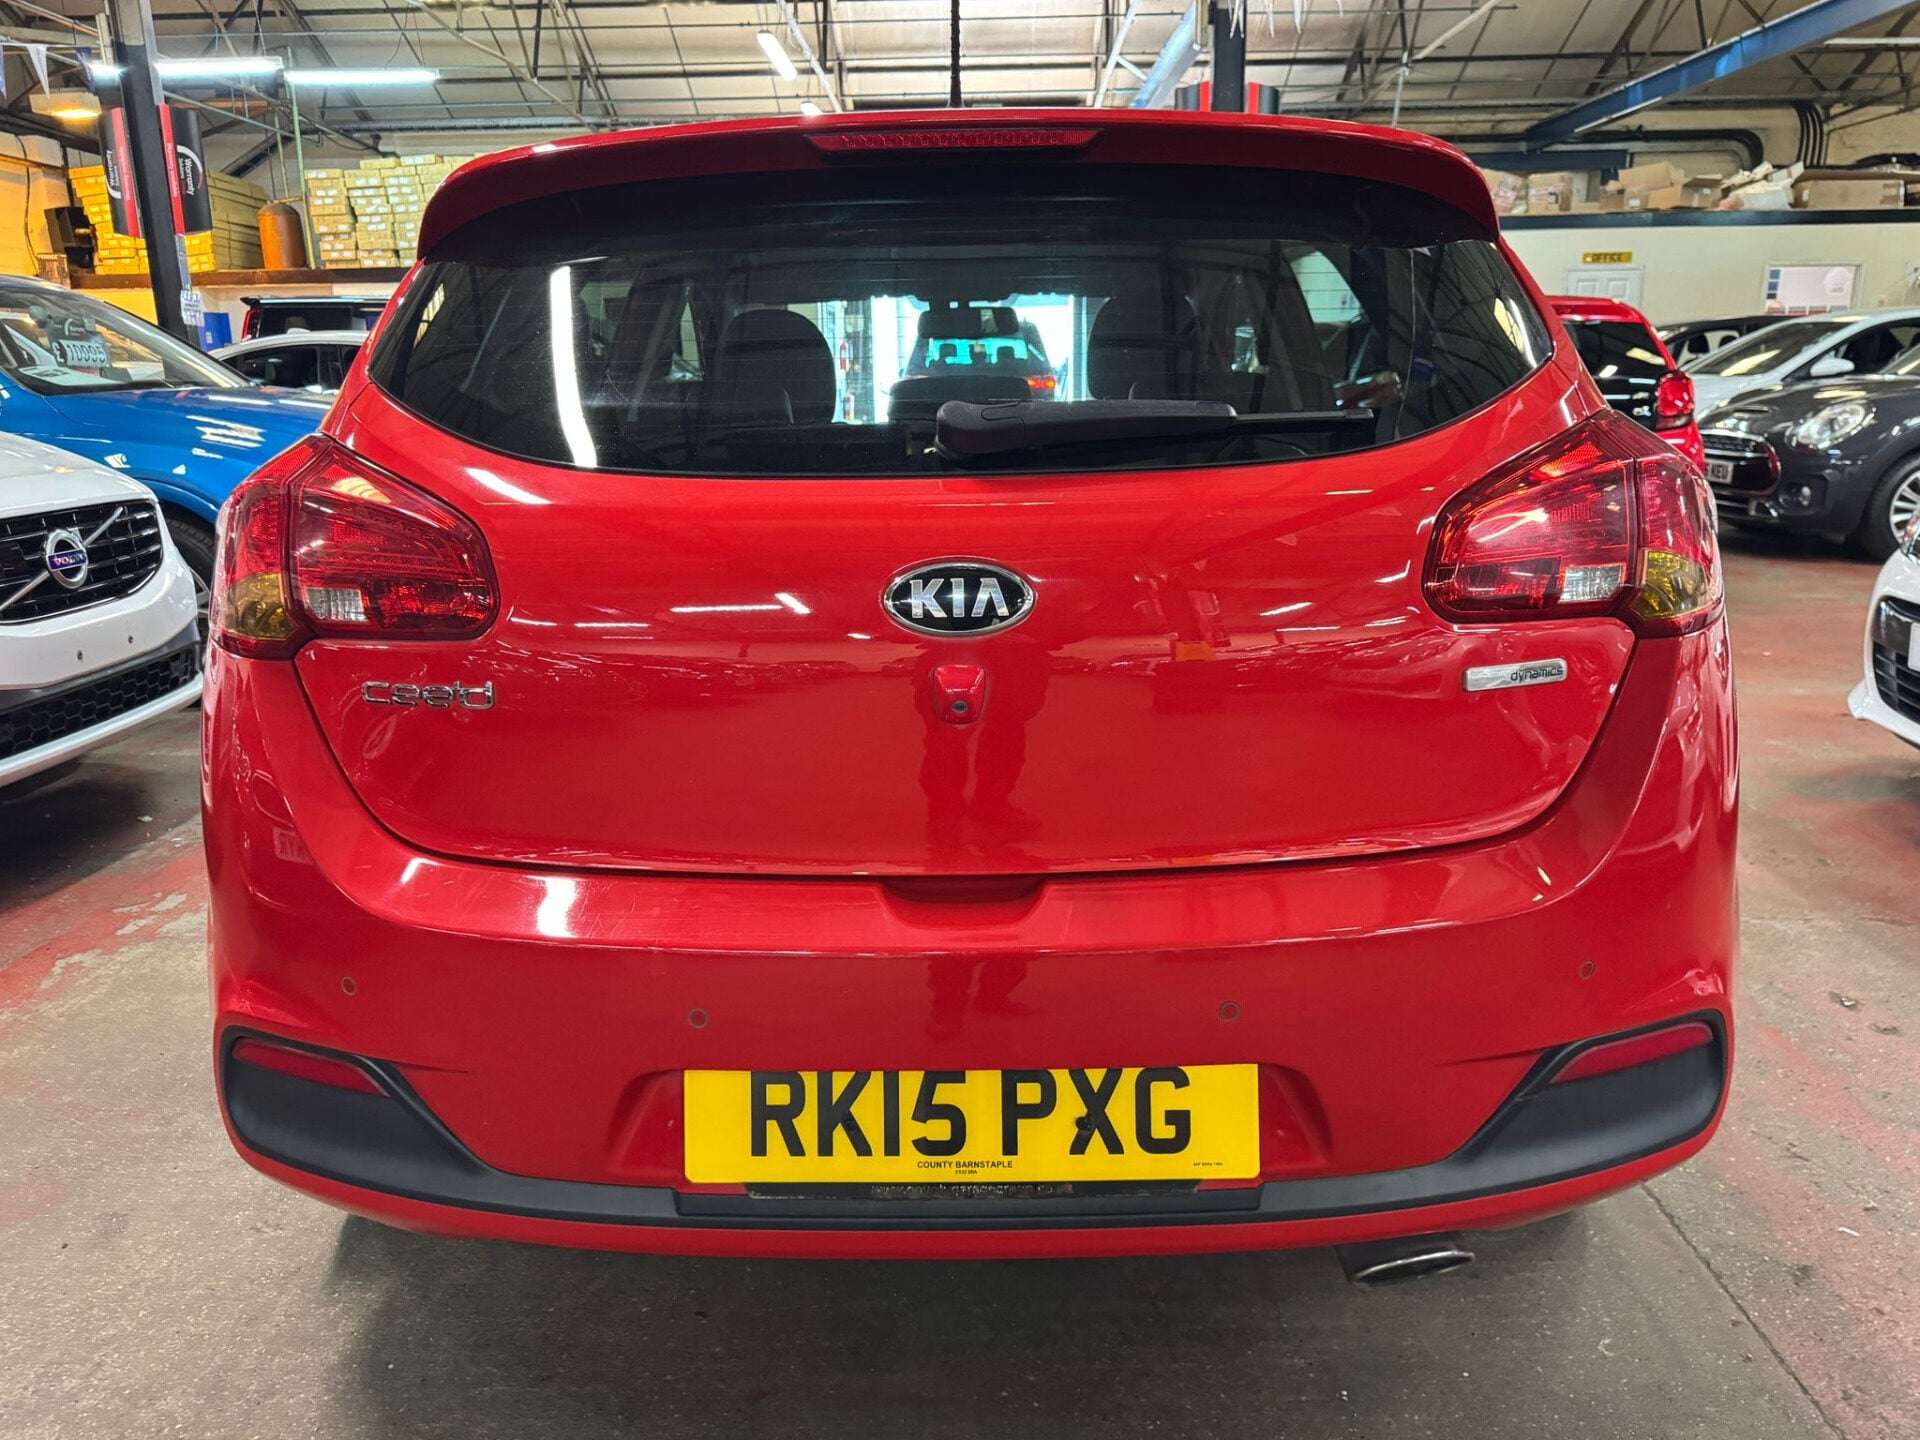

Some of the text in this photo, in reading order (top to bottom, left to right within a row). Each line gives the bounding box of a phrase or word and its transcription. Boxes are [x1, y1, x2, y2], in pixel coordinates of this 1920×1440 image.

[185, 158, 195, 196] Warranty
[910, 577, 1010, 619] KIA
[751, 1066, 1192, 1157] RK15 PXG
[917, 1160, 1013, 1169] COUNTY BARNSTAPLE
